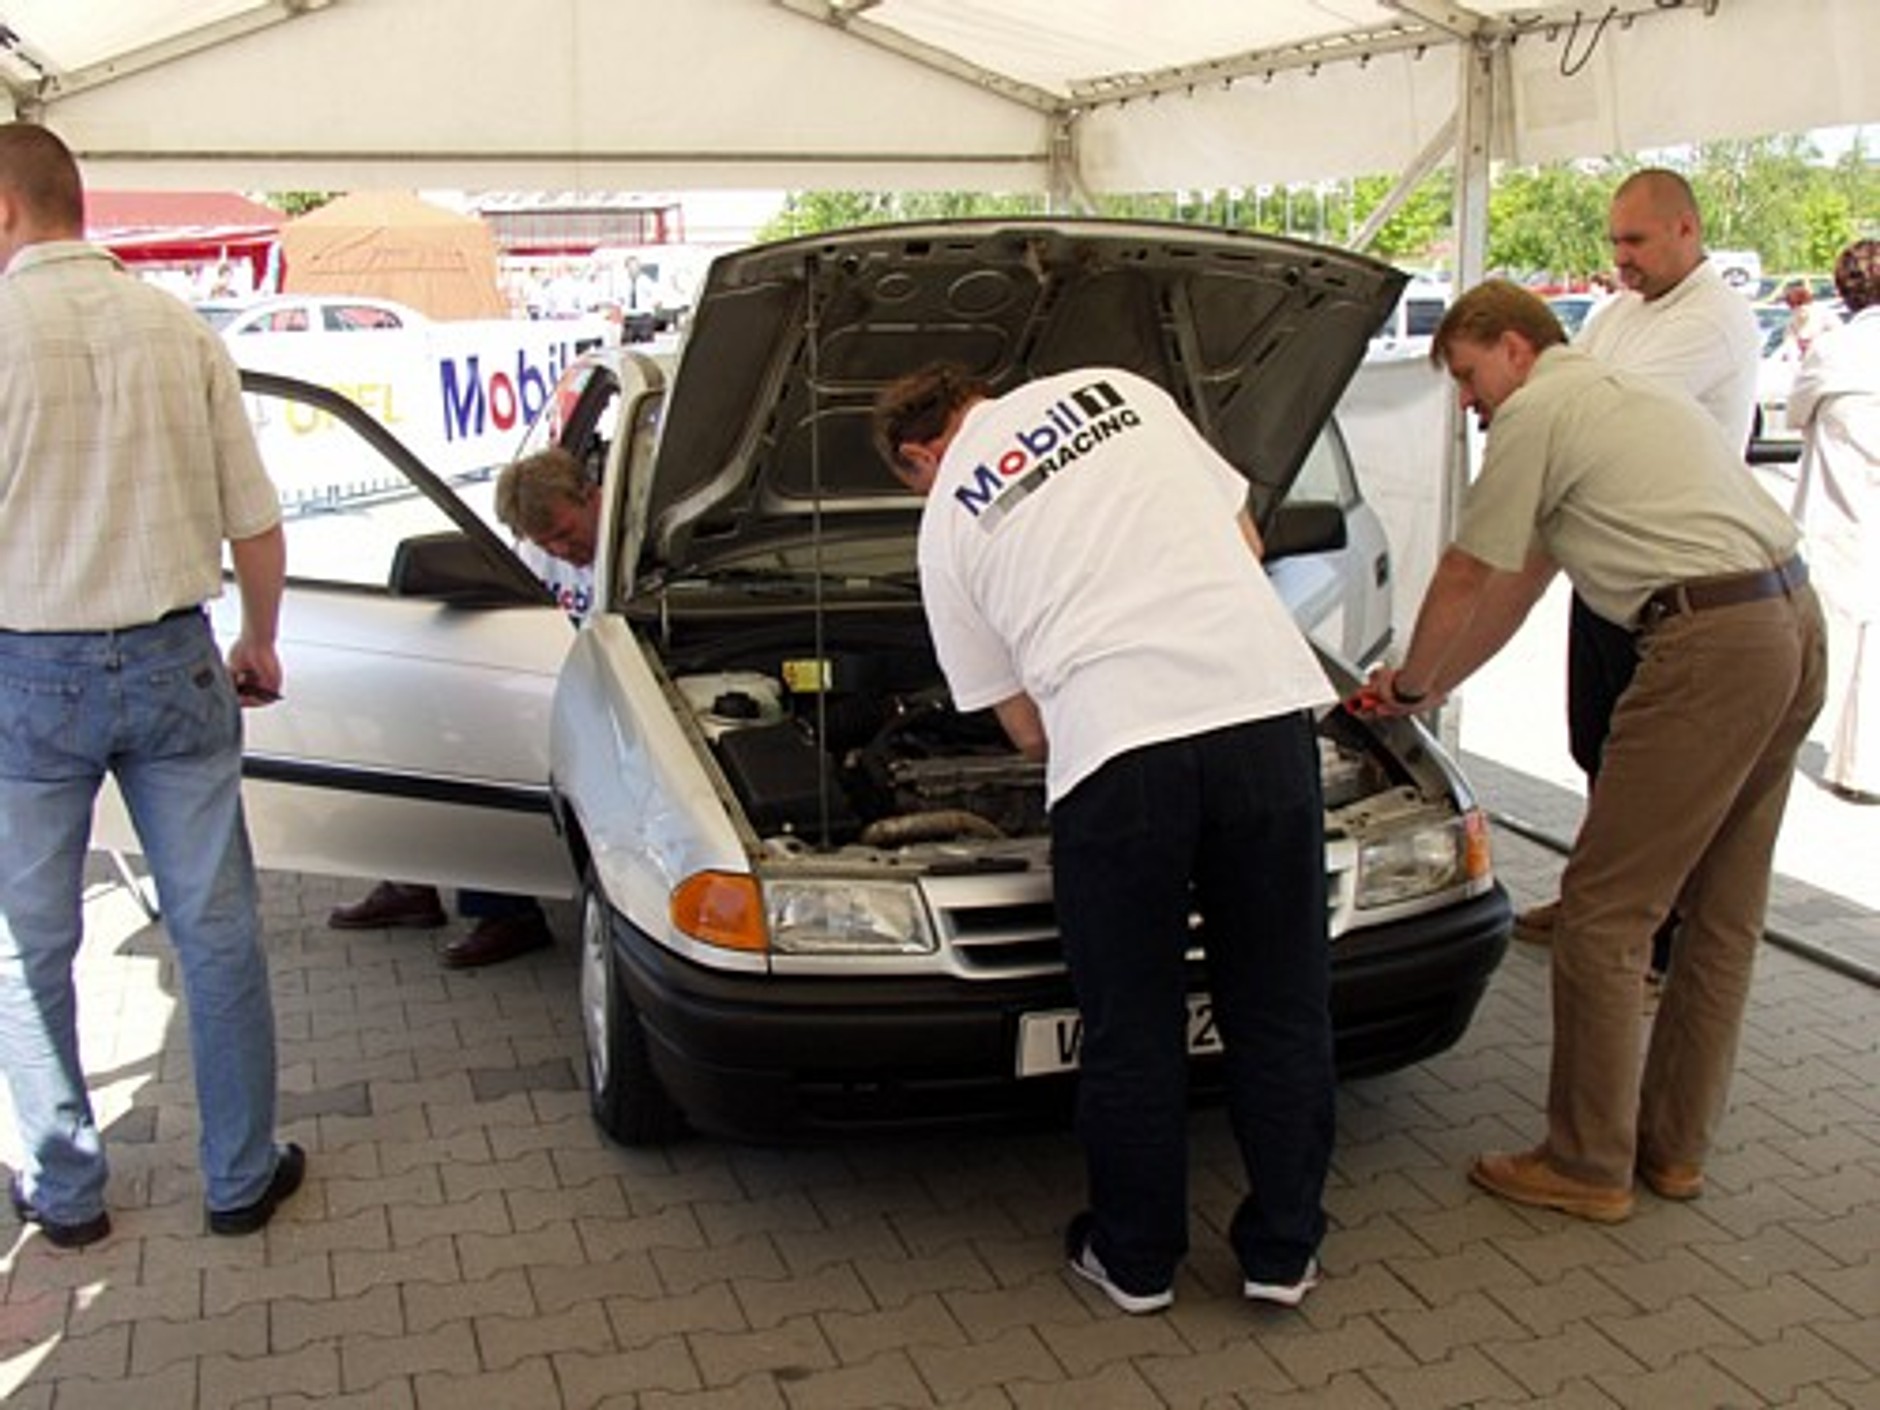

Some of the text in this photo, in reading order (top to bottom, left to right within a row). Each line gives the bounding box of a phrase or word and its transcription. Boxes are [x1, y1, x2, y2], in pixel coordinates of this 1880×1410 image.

[286, 381, 404, 435] OEL
[954, 401, 1083, 517] Mobil
[1039, 409, 1141, 479] RACING
